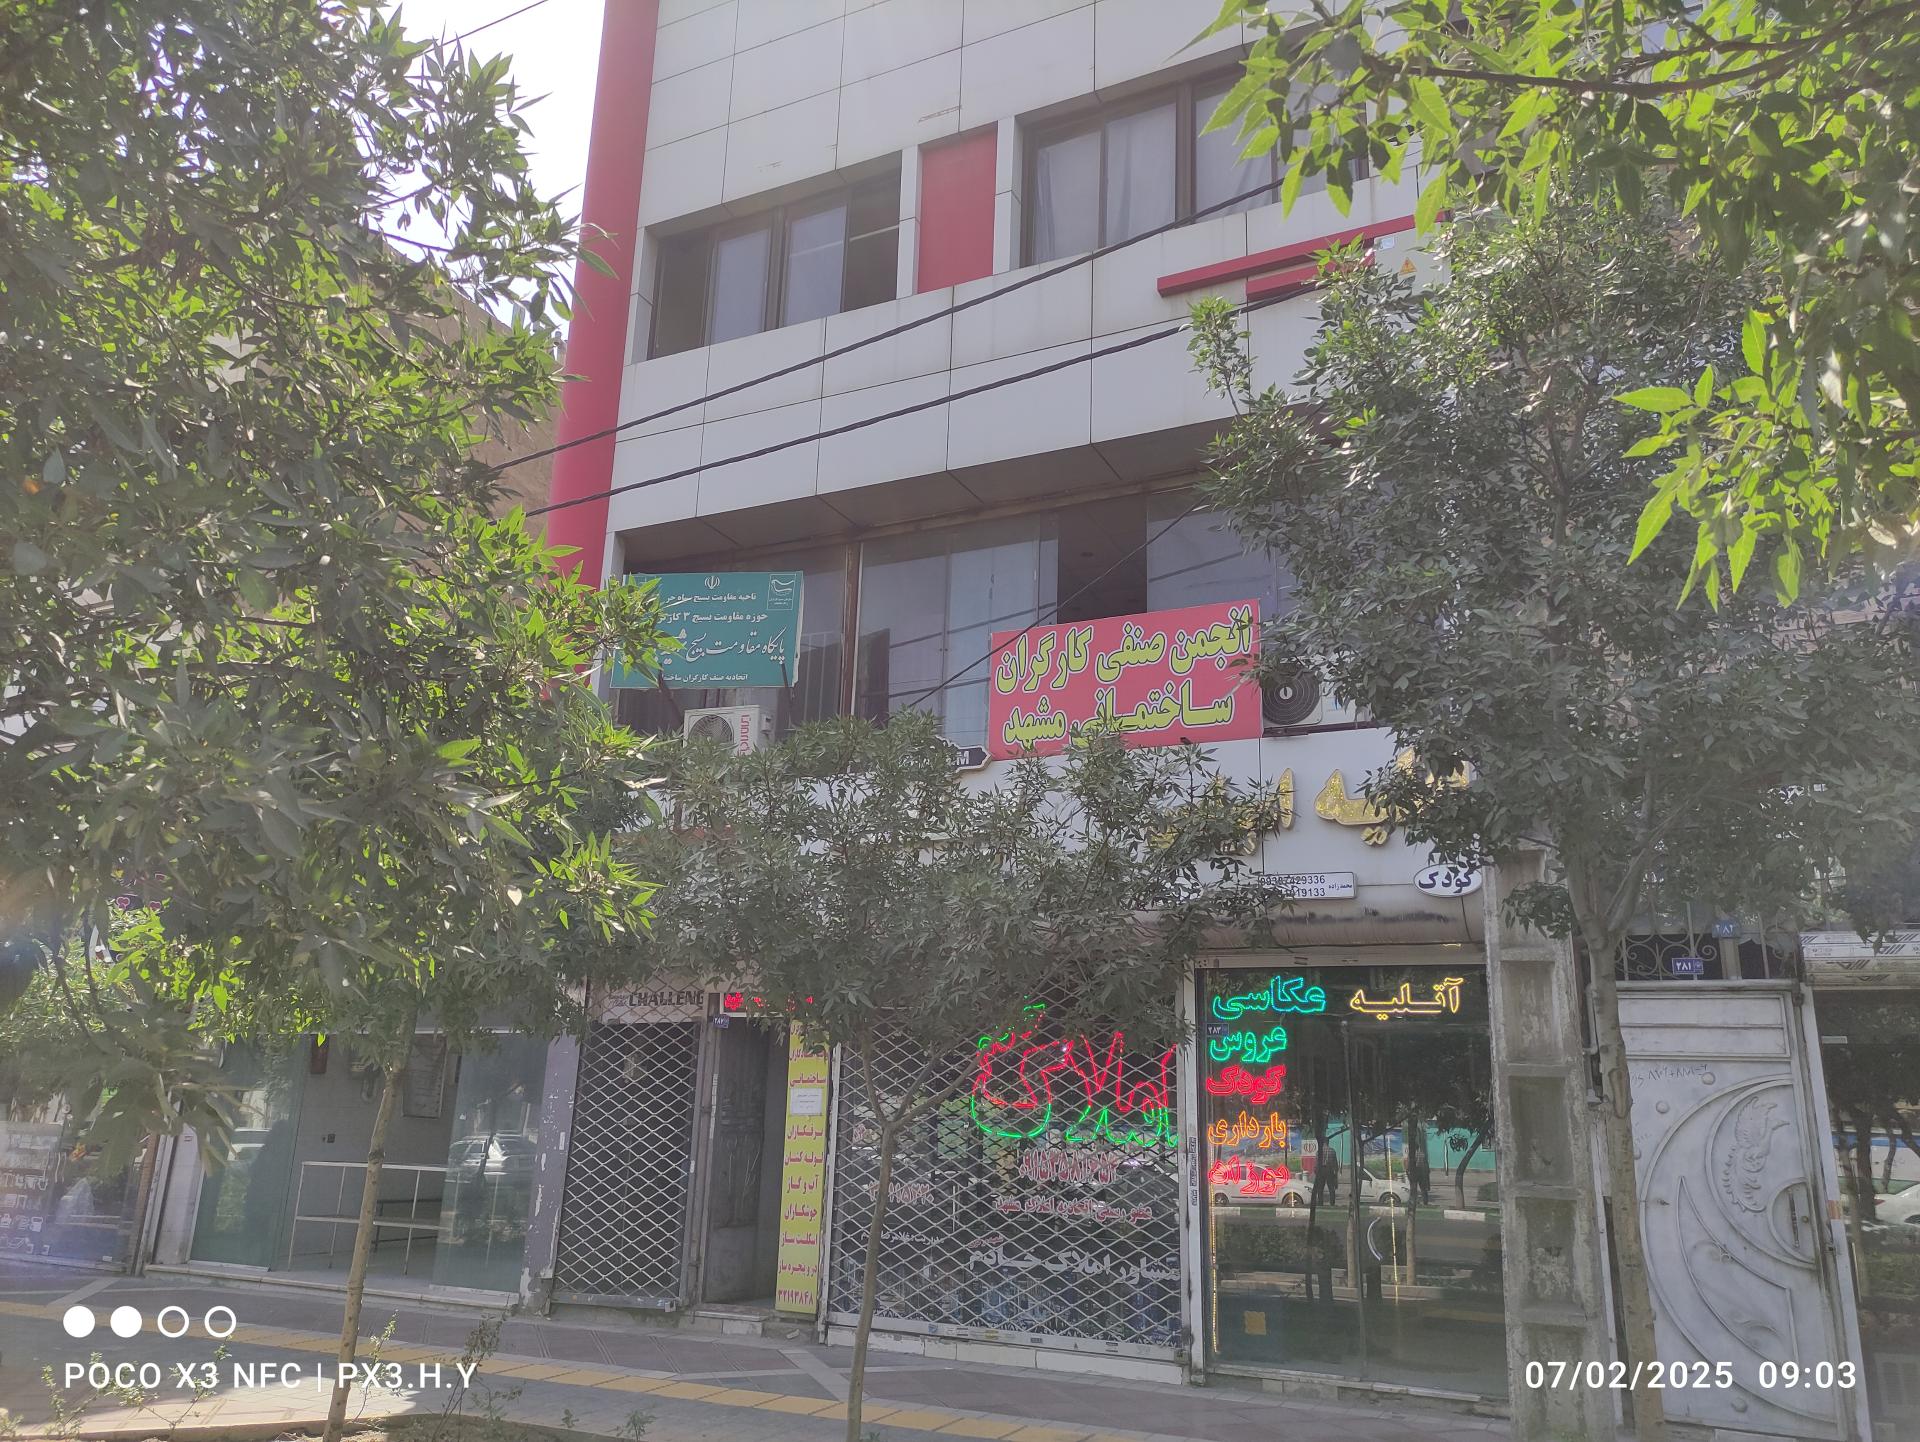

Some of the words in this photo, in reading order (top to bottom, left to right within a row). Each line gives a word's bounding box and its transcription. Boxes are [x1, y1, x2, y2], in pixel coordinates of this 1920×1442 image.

[693, 593, 711, 603] بسیج
[712, 592, 737, 602] مقاومت
[683, 612, 690, 621] ۳
[692, 612, 712, 624] بسیج
[714, 612, 744, 623] مقاومت
[746, 613, 768, 623] حوزه
[686, 632, 707, 662] بسیج
[705, 630, 761, 655] مقاومت
[761, 626, 787, 664] پایگاه
[1096, 621, 1167, 683] صنفی
[1170, 604, 1254, 677] انجمن
[995, 625, 1094, 695] کارگران
[683, 673, 709, 683] کارگران
[709, 673, 725, 682] صنف
[726, 673, 748, 682] اتحادیه
[1002, 695, 1068, 750] مشهد
[1069, 678, 1235, 749] ساختمانی
[1418, 869, 1473, 894] کودک
[1676, 962, 1692, 971] ۲۸۱
[1212, 975, 1327, 1020] عکاسی
[1350, 977, 1464, 1021] آتلیه
[1209, 1026, 1288, 1063] عروس
[1206, 1064, 1287, 1104] کودک
[1207, 1110, 1287, 1148] بارداری
[1044, 1250, 1111, 1276] املاک
[1114, 1256, 1180, 1286] مشاور
